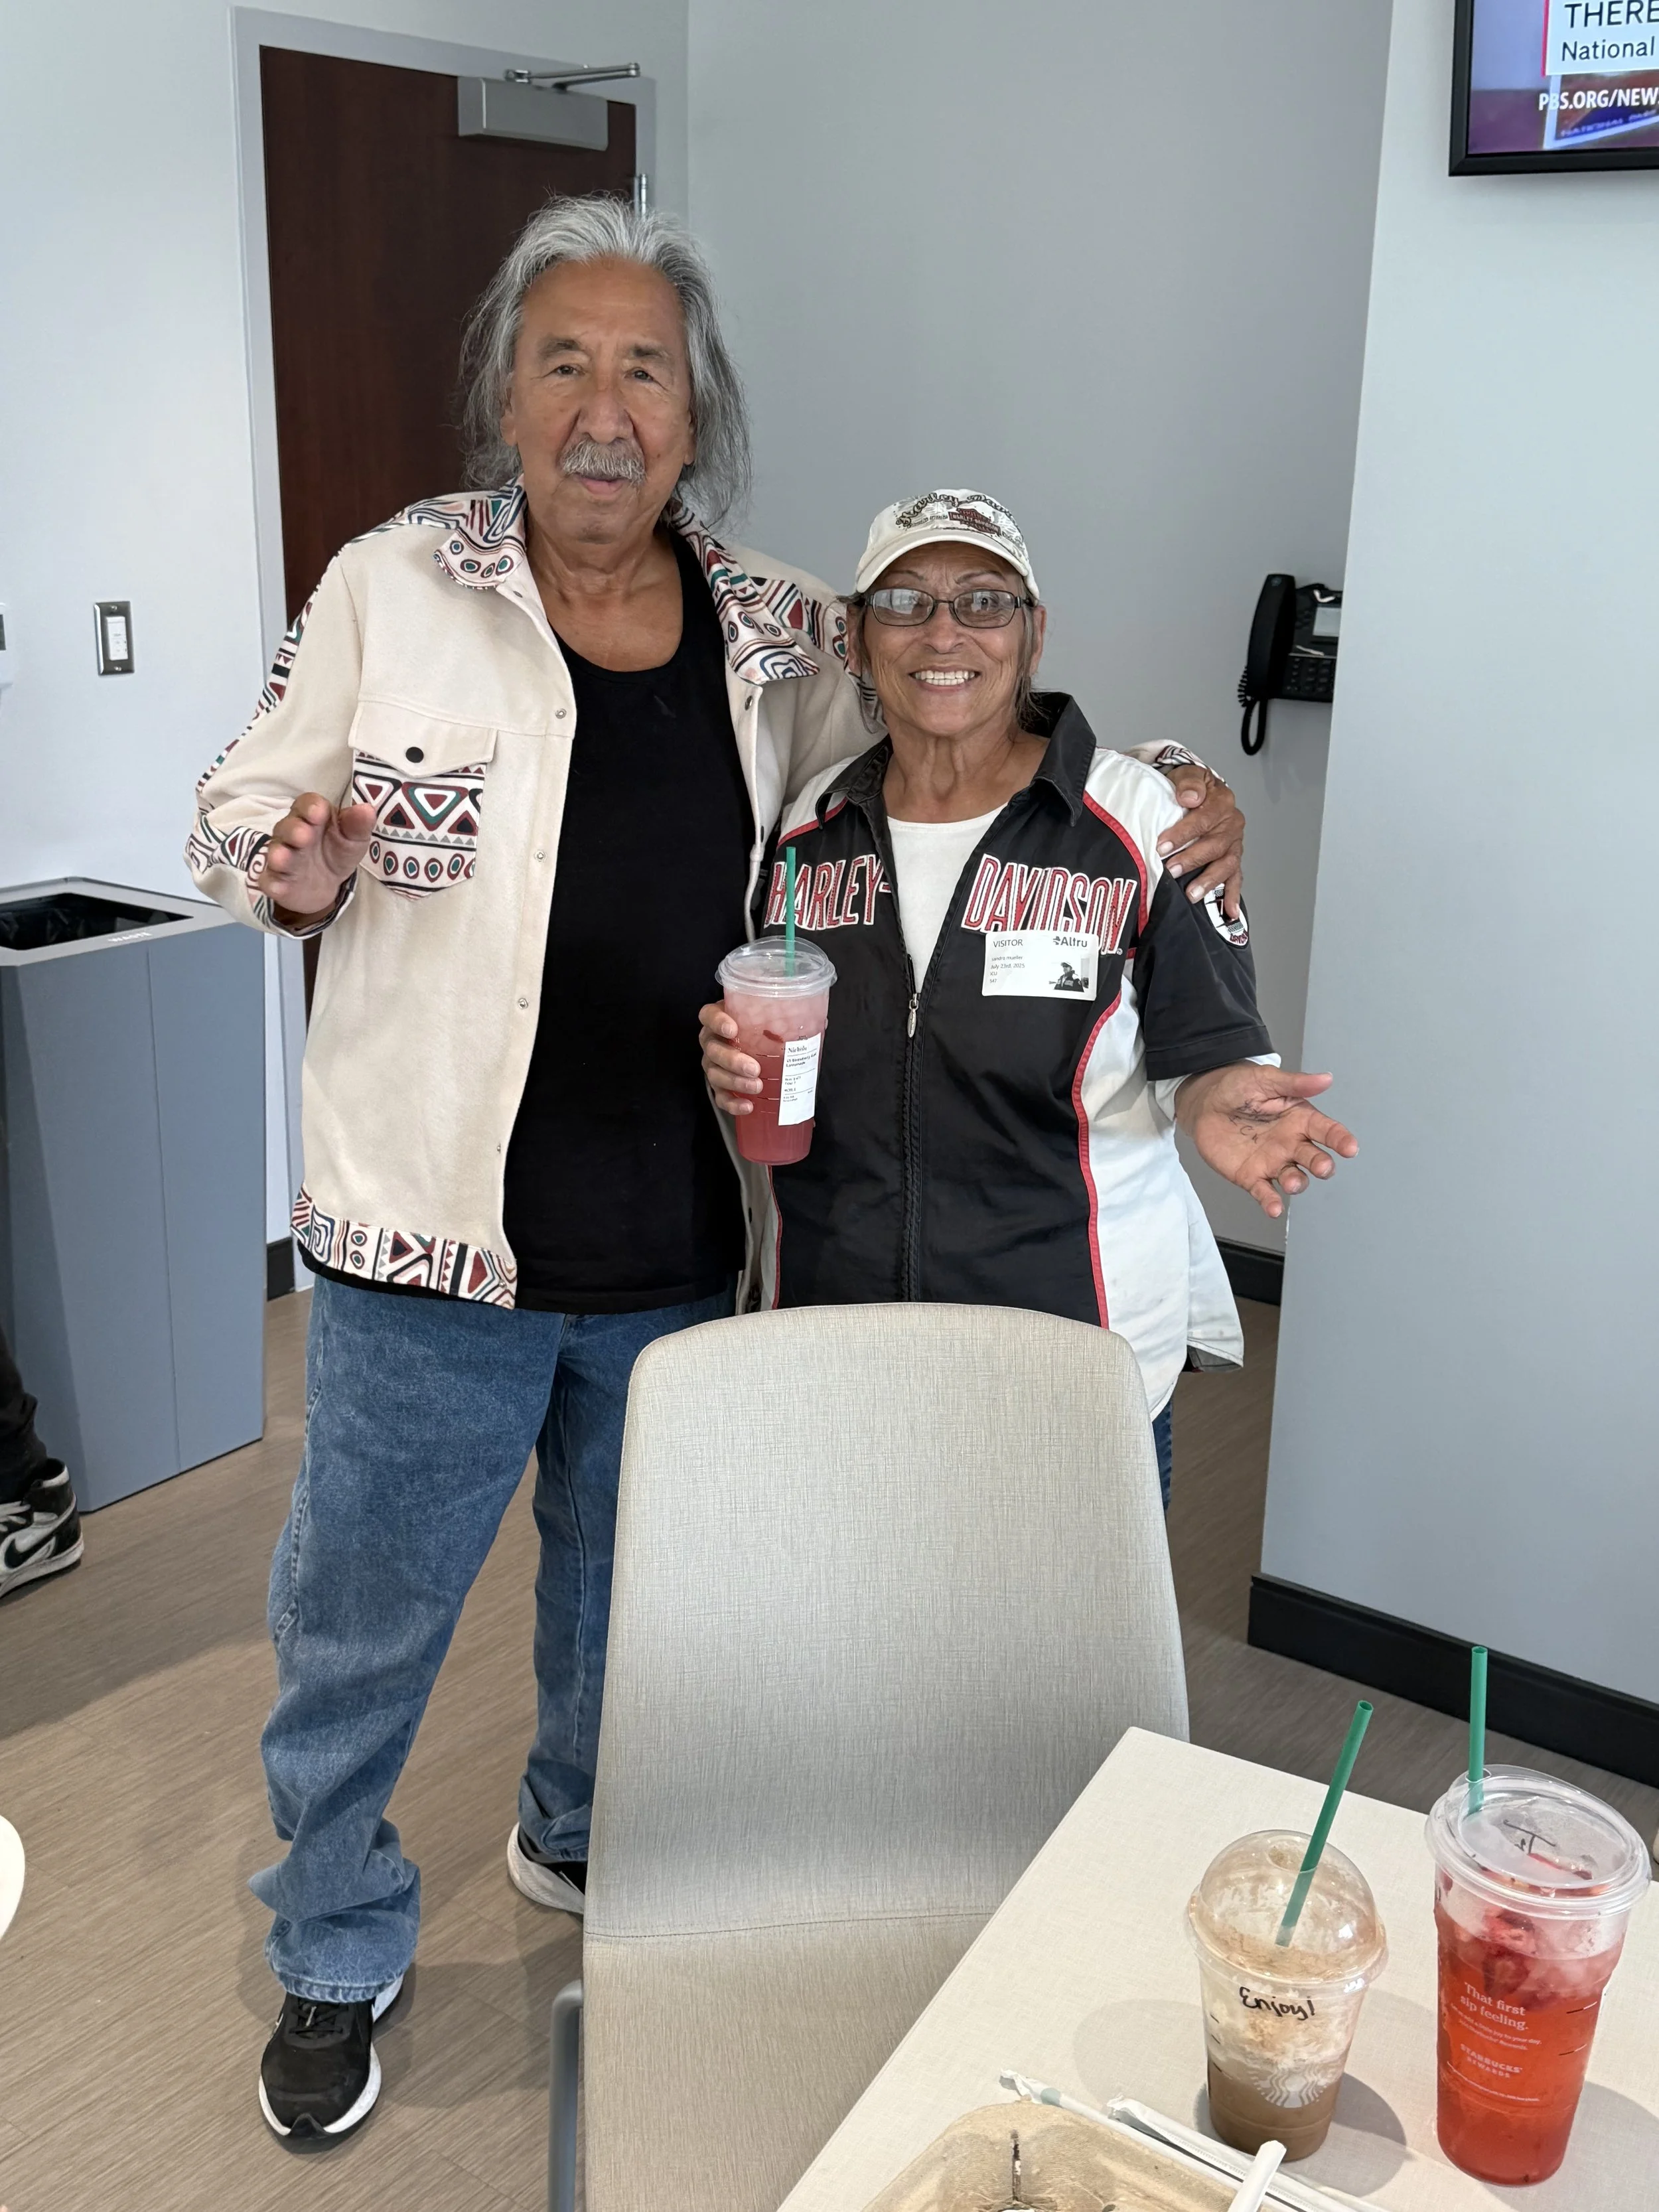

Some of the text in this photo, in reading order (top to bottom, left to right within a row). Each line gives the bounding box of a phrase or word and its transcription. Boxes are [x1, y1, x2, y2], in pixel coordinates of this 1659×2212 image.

[1564, 0, 1659, 29] THERE
[1561, 36, 1655, 61] National
[1538, 87, 1659, 111] PBS.ORG/NEW
[962, 853, 1137, 955] DAVIDSON
[993, 938, 1023, 948] VISITOR
[1060, 936, 1088, 947] Altru
[1240, 1986, 1315, 2021] Enjoy!
[1465, 1981, 1526, 2016] That first
[1460, 1996, 1477, 2012] sip
[1480, 2006, 1528, 2031] feeling.
